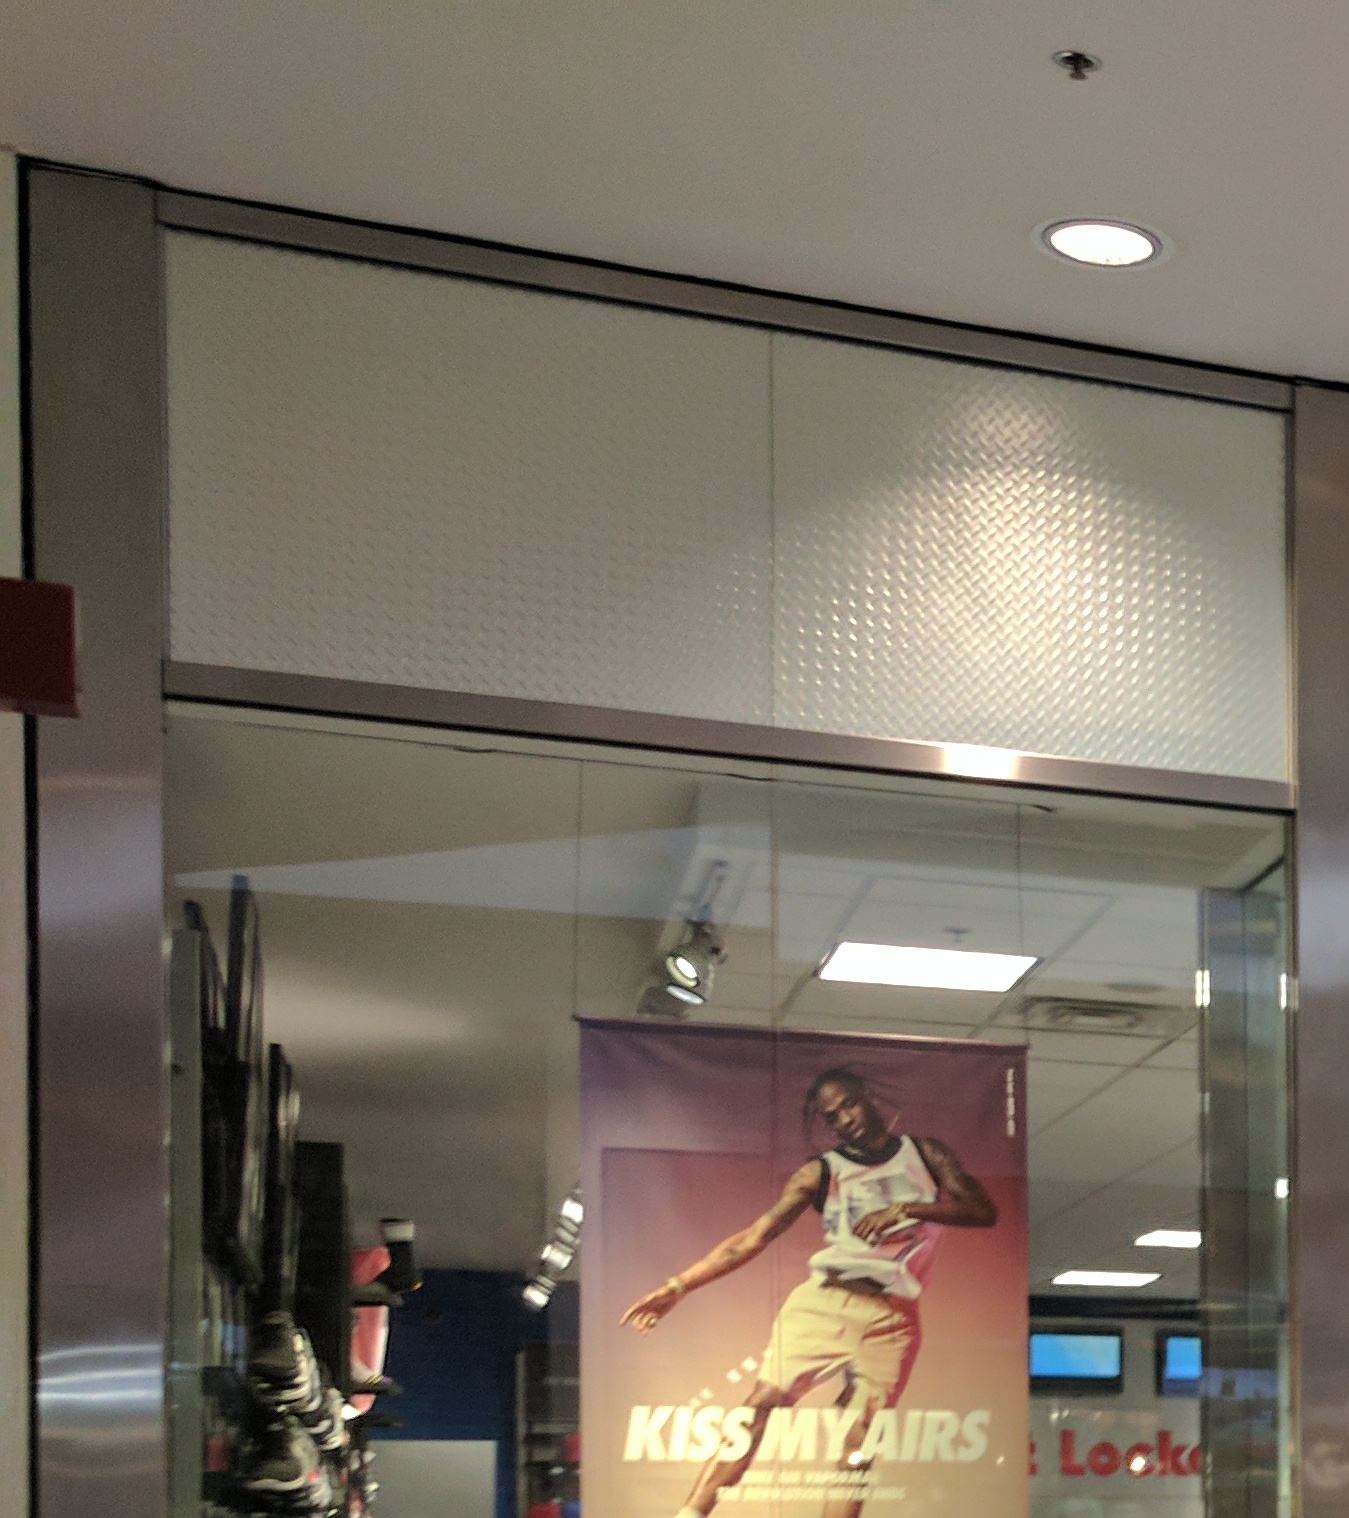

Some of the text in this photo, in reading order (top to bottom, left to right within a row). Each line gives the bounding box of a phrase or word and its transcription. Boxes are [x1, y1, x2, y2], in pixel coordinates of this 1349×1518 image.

[624, 1405, 756, 1462] KISS
[756, 1407, 859, 1463] MY
[860, 1409, 992, 1463] AIRS
